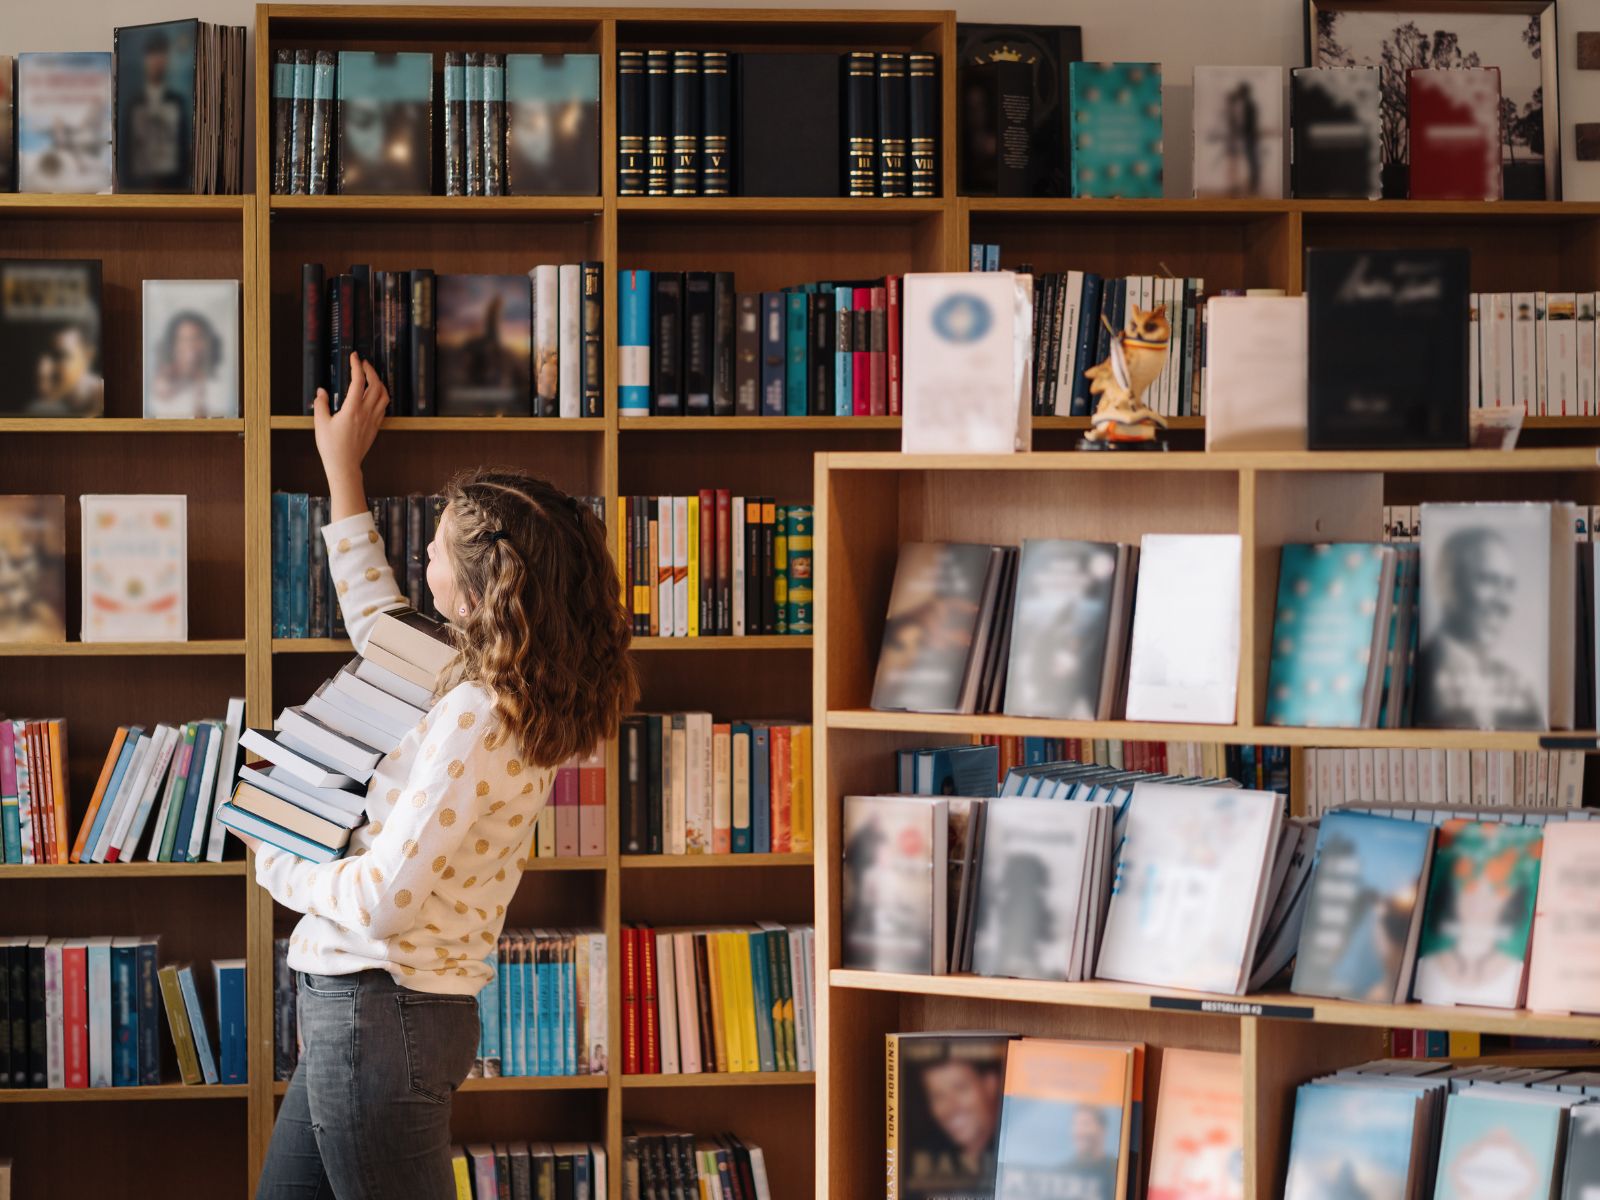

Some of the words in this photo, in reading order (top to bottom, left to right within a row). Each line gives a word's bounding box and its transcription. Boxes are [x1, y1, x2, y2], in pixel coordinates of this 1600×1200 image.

[652, 156, 665, 167] III
[680, 155, 692, 166] IV
[712, 156, 721, 167] V
[886, 158, 901, 168] VII
[915, 159, 933, 169] VIII
[1201, 1002, 1250, 1013] BESTSELLER
[887, 1040, 895, 1099] ROBBINS
[887, 1104, 895, 1139] TONY
